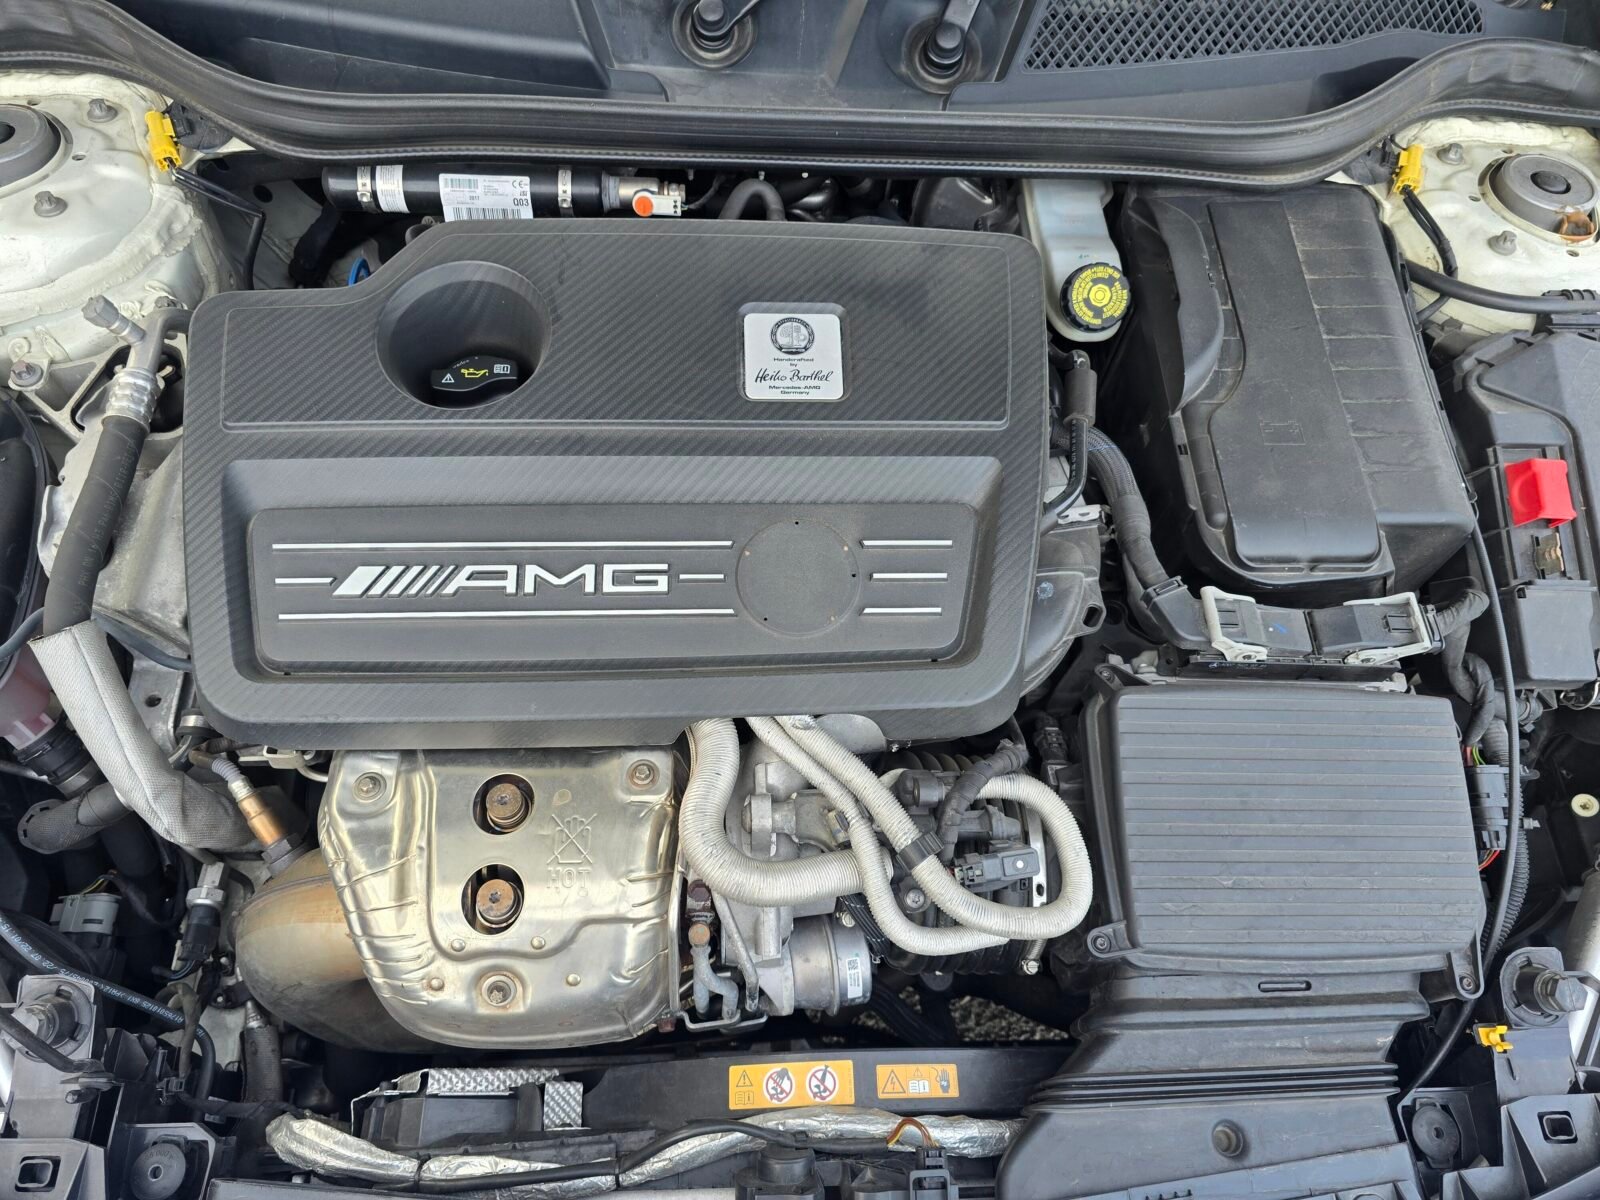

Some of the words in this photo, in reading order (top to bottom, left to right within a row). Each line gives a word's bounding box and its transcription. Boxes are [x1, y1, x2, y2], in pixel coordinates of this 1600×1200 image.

[513, 198, 529, 207] Q03
[754, 368, 787, 384] Heiko
[789, 369, 834, 383] Barthel
[440, 563, 669, 597] AMG
[546, 866, 592, 889] HOT
